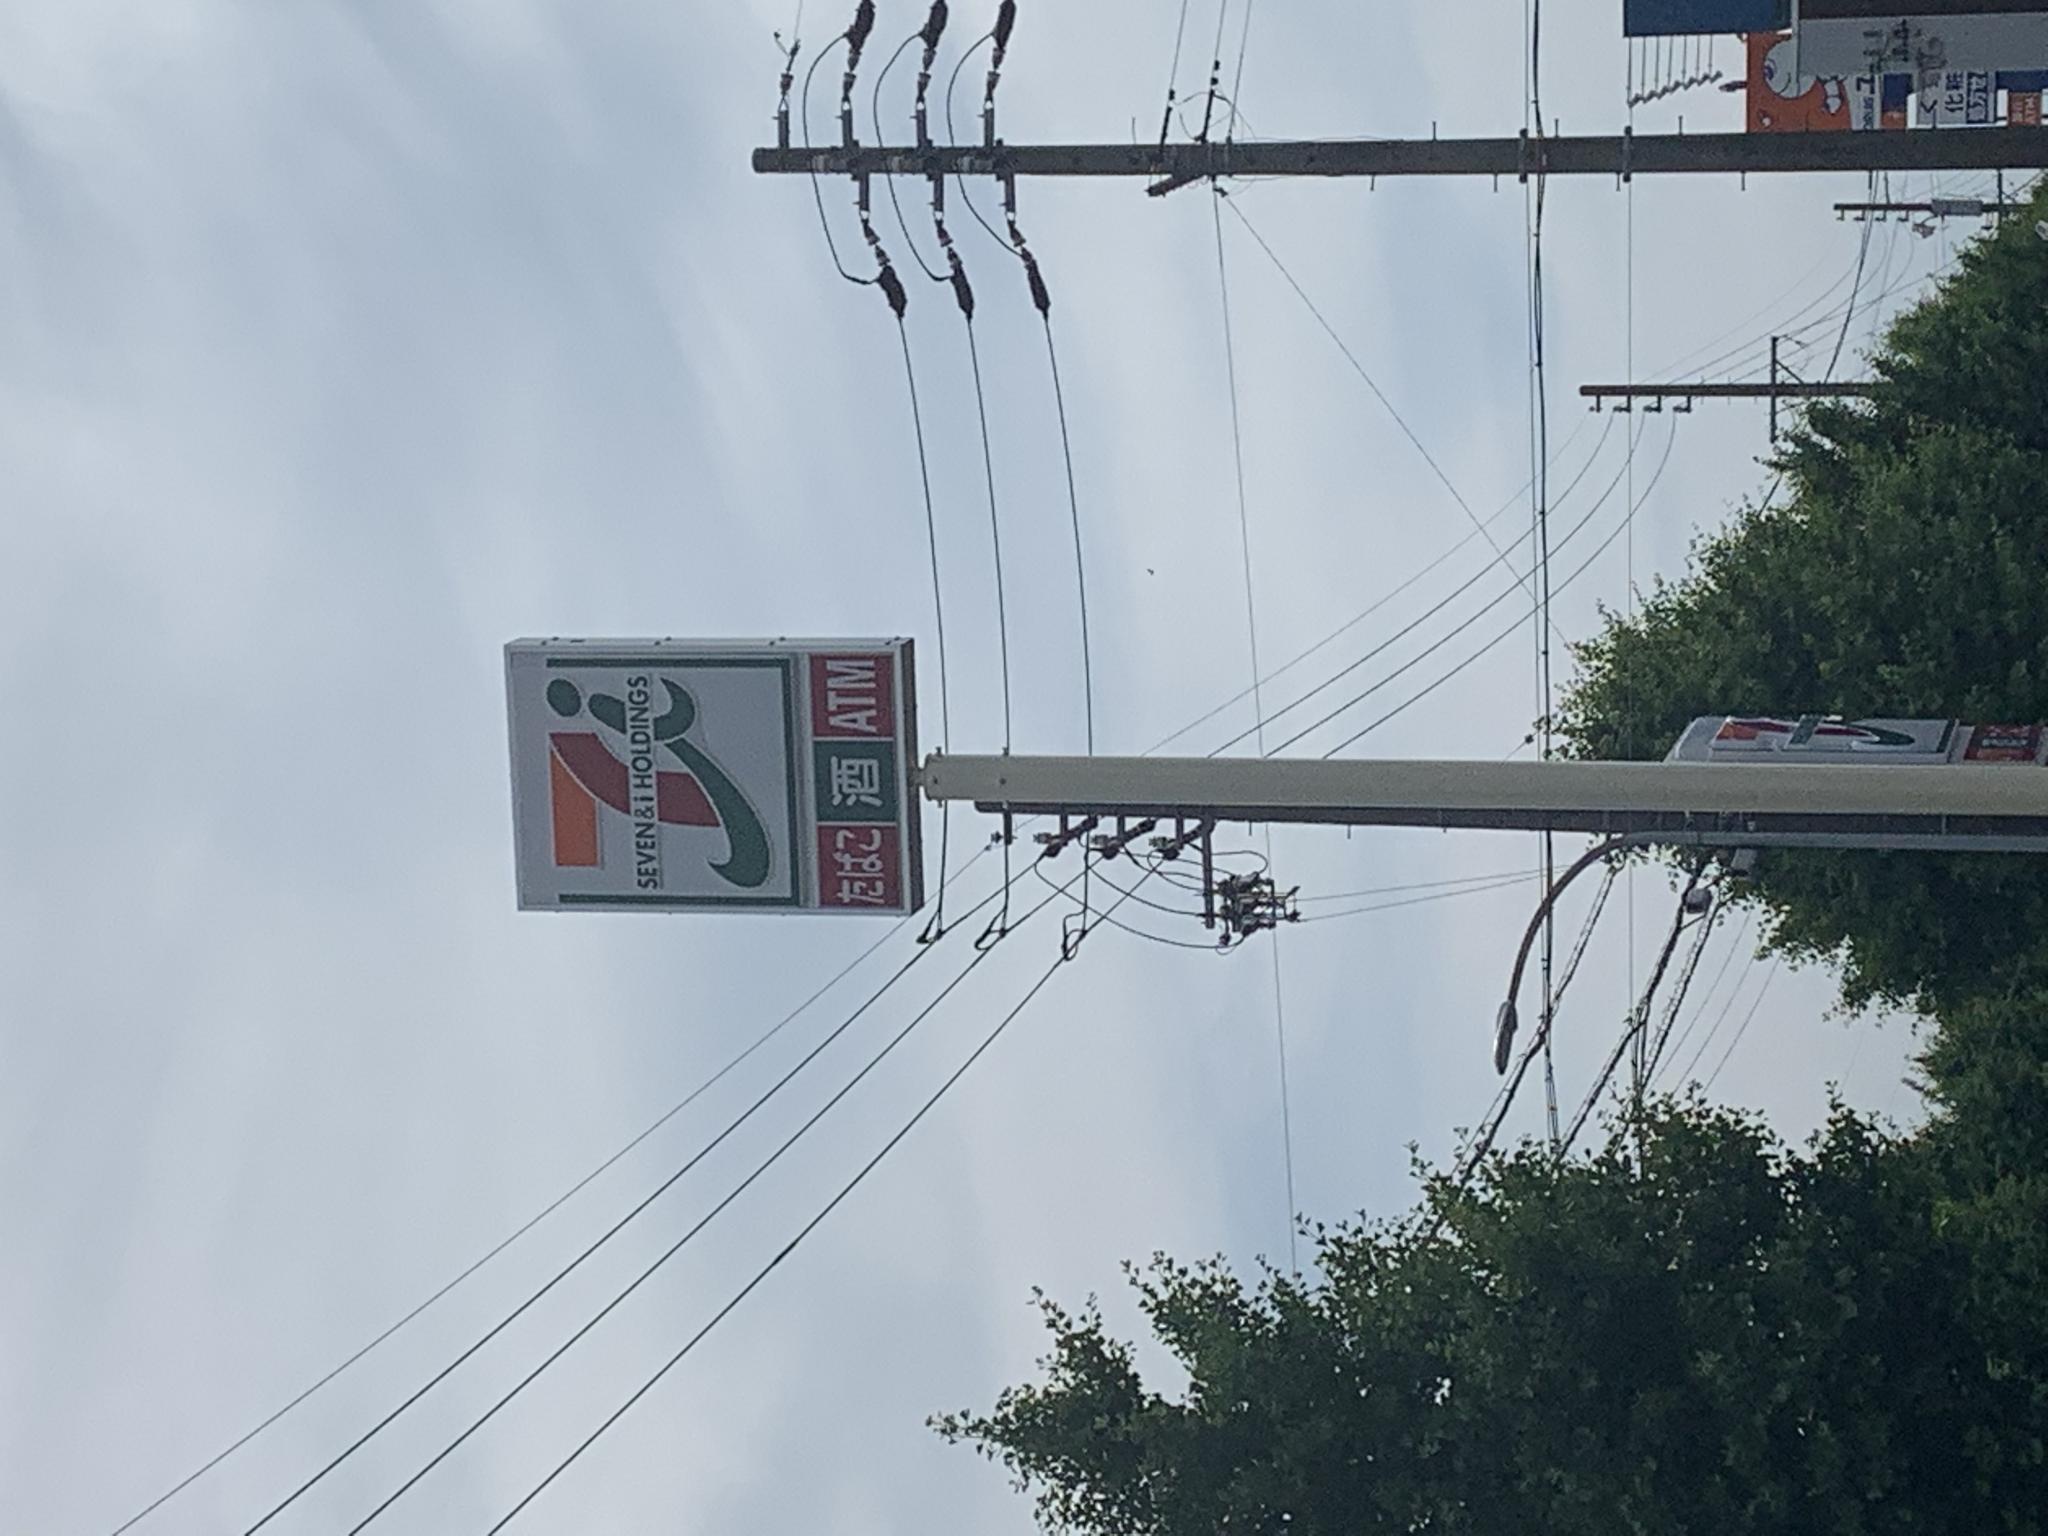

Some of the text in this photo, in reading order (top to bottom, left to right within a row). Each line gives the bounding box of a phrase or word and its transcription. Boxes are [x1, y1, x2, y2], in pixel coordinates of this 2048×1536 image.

[1969, 73, 1987, 121] 処方せ
[627, 676, 654, 790] HOLDINGS
[827, 660, 877, 733] ATM
[830, 756, 882, 806] 酒
[834, 828, 885, 904] たばこ
